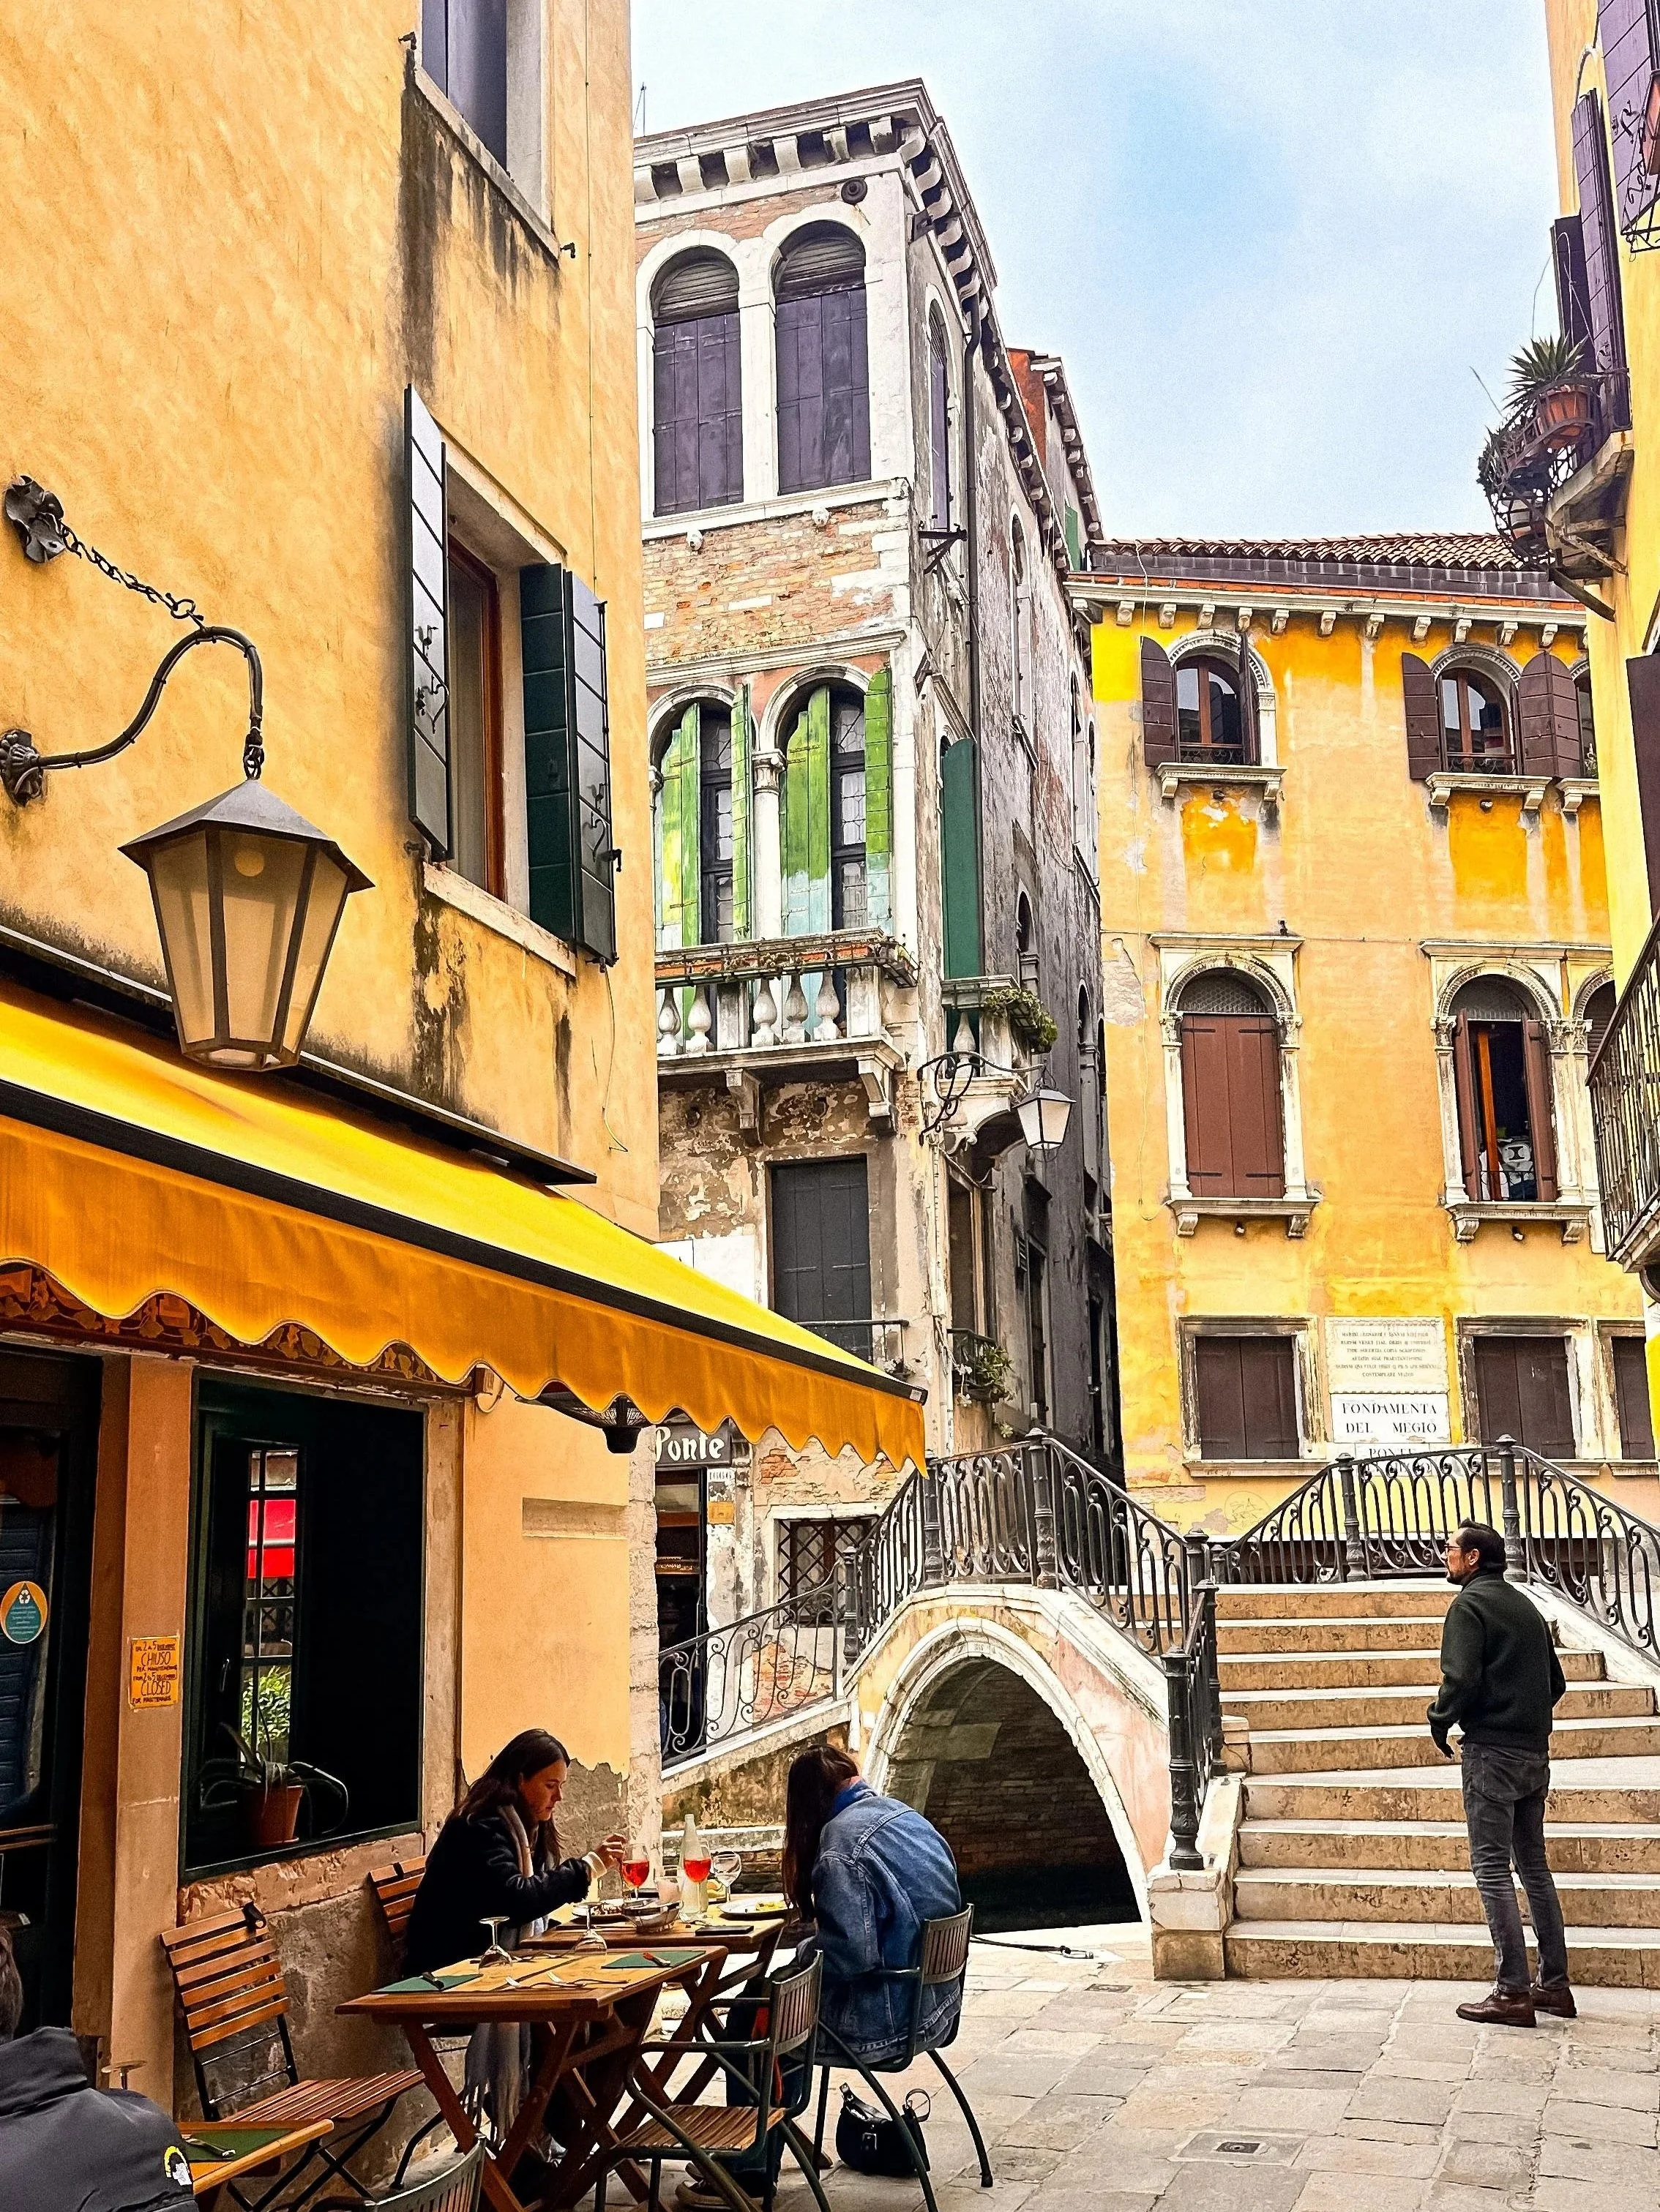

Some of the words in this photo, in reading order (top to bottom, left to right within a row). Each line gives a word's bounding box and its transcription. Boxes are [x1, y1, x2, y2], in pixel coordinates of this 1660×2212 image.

[1342, 1403, 1437, 1414] FONDAMENTA
[1346, 1422, 1373, 1433] DEL
[656, 1426, 725, 1463] Ponte
[152, 1640, 157, 1650] 5
[141, 1651, 171, 1666] CHIUSO
[152, 1671, 157, 1682] 5
[141, 1681, 171, 1696] CLOSED
